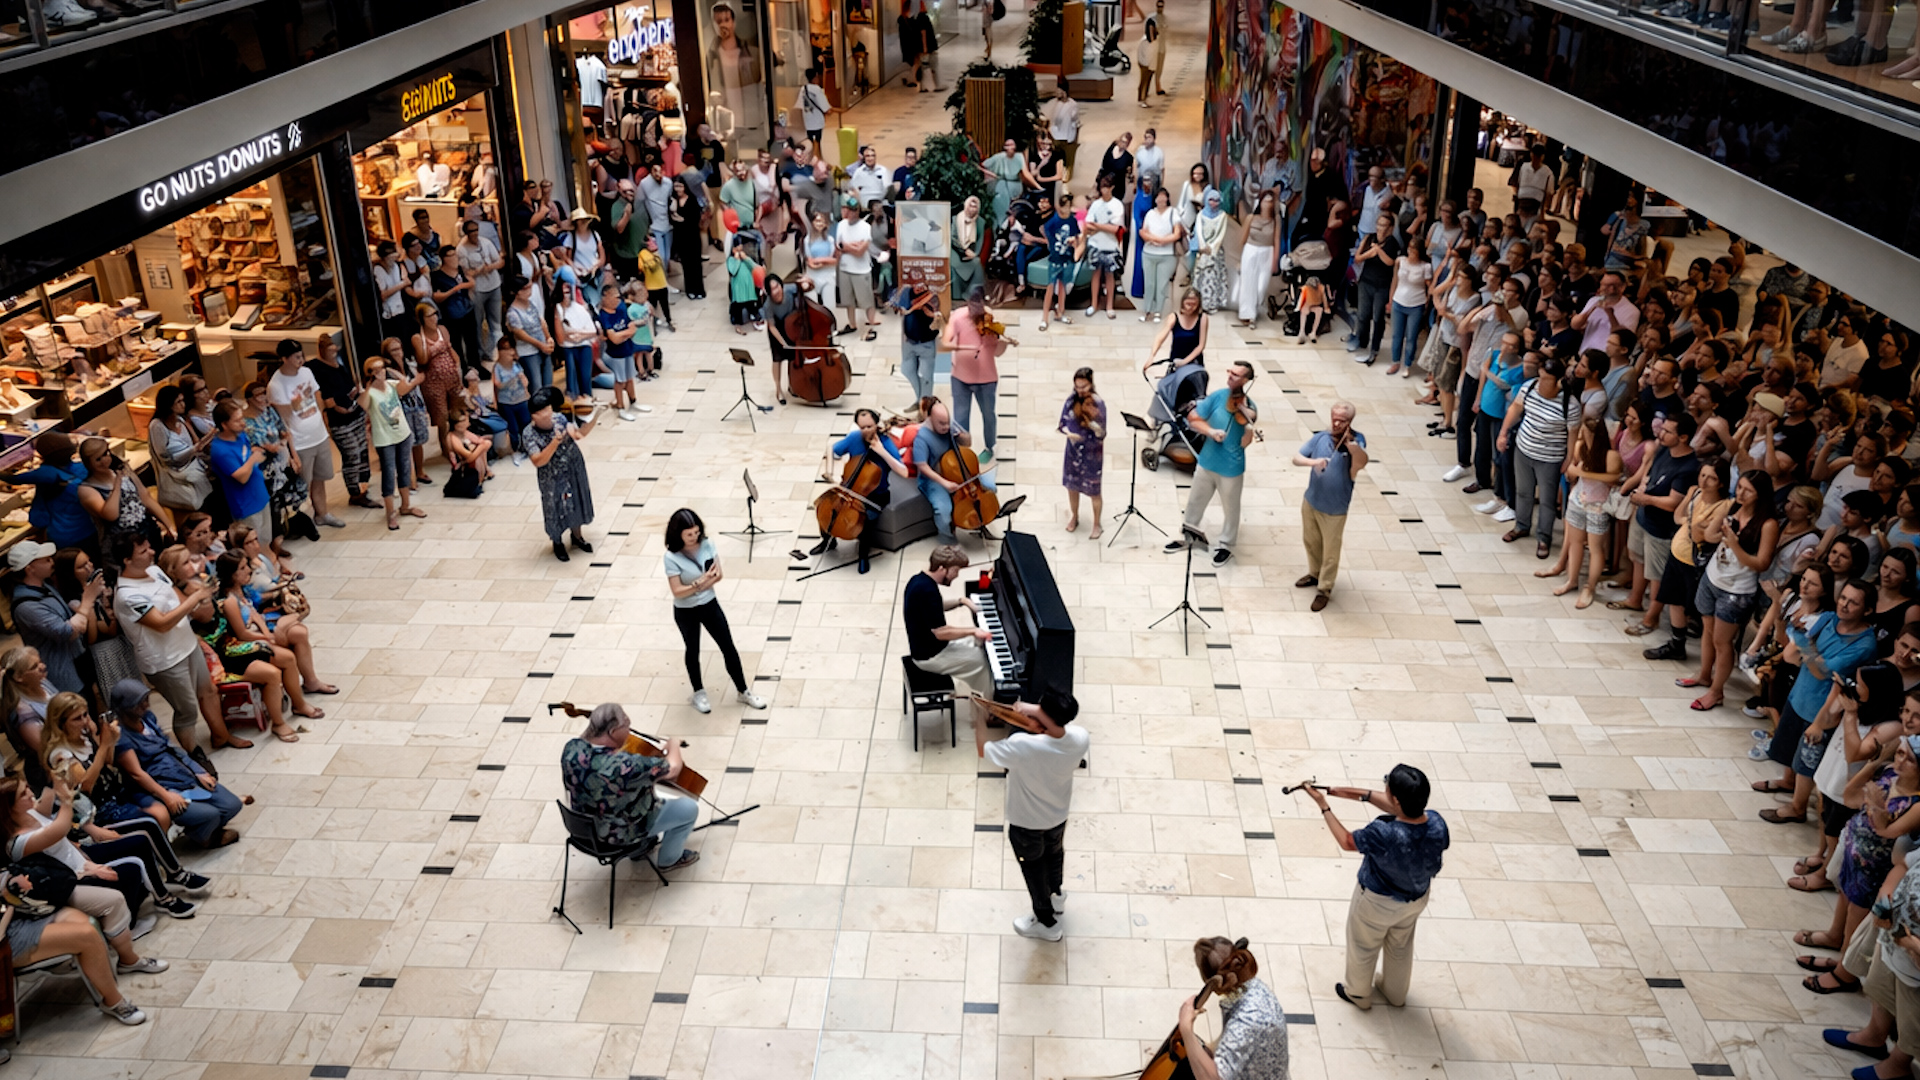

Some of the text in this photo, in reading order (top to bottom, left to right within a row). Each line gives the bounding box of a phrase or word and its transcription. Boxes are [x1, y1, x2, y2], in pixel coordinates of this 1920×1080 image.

[140, 133, 282, 212] GO NUTS DONUTS
